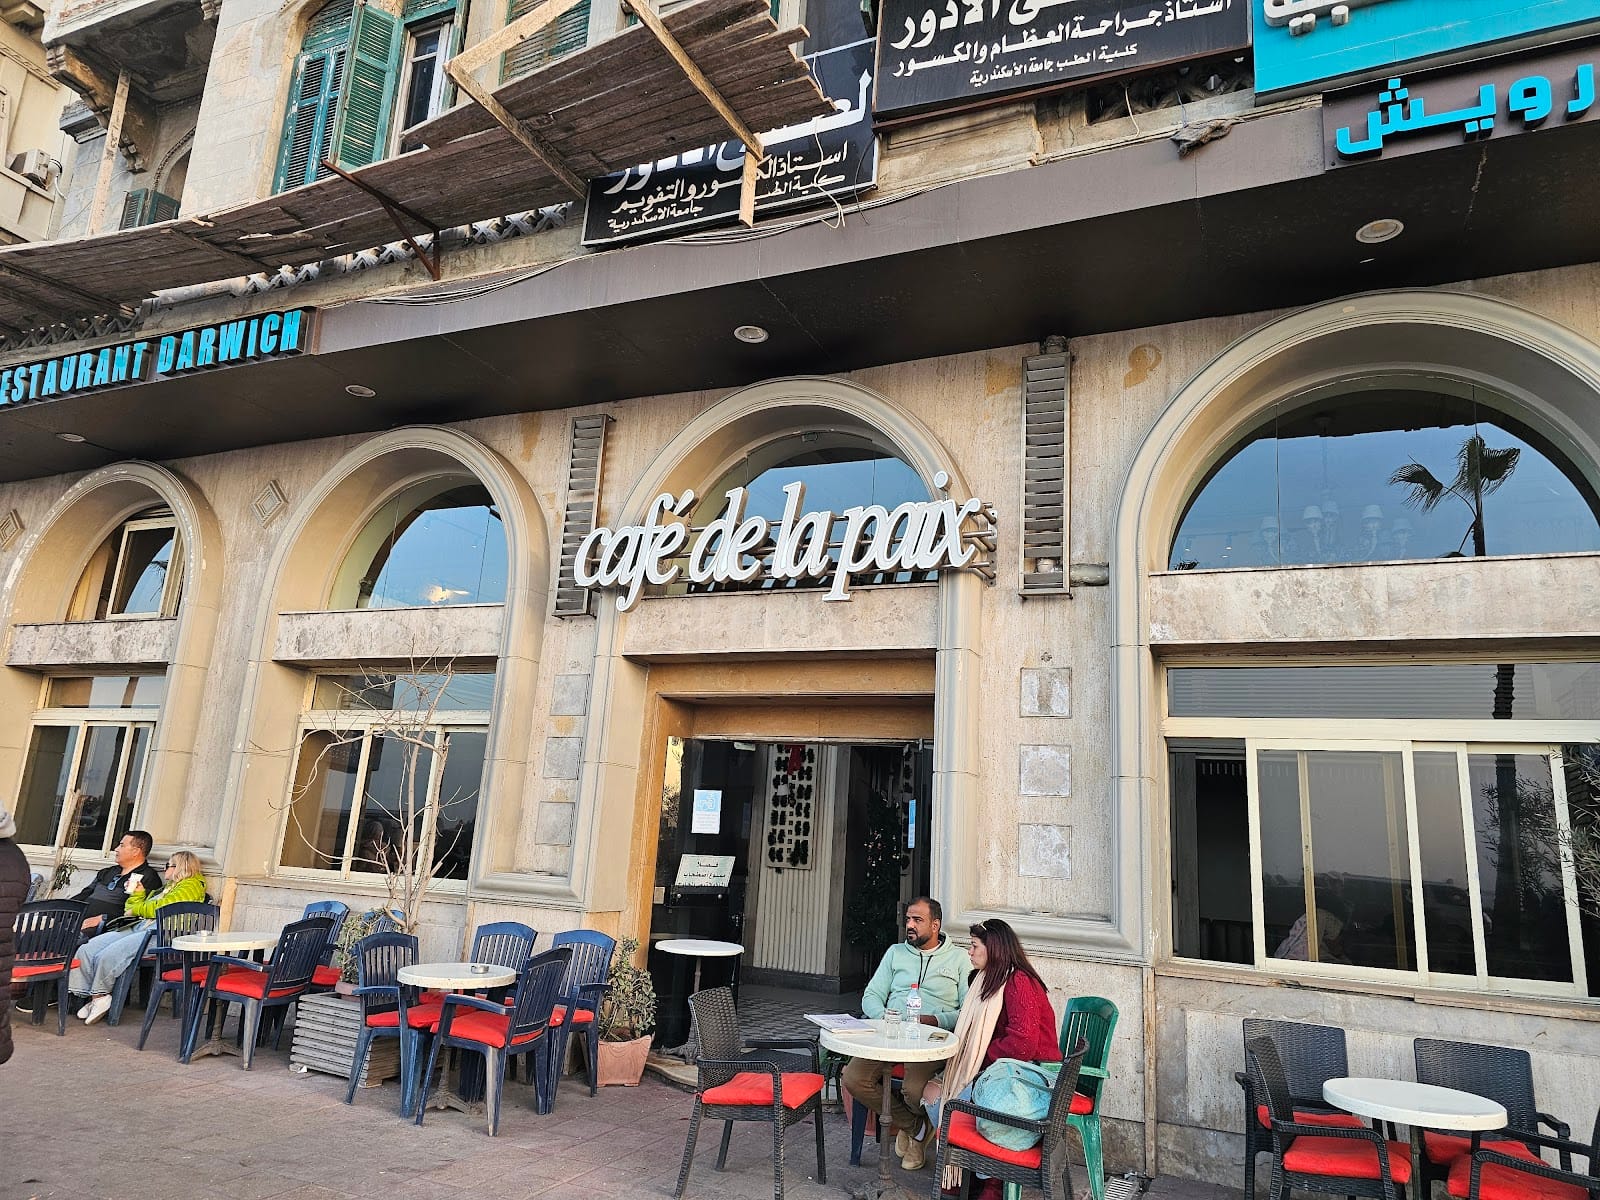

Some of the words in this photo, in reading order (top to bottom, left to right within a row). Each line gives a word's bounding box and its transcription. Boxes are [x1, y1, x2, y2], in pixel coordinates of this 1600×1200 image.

[1069, 9, 1163, 38] جراحة
[892, 41, 988, 77] والكسور
[990, 21, 1070, 63] العظام
[1055, 49, 1096, 70] الطب
[1097, 42, 1138, 63] كلية
[1028, 56, 1054, 73] جامعة
[694, 153, 777, 199] الكور
[777, 140, 848, 177] استاذ
[669, 199, 704, 217] جامعة
[0, 342, 149, 404] ESTAURANT
[156, 309, 303, 374] DARWICH
[573, 488, 695, 612] café
[688, 486, 770, 583] de
[771, 480, 834, 580] la
[821, 470, 983, 602] paix
